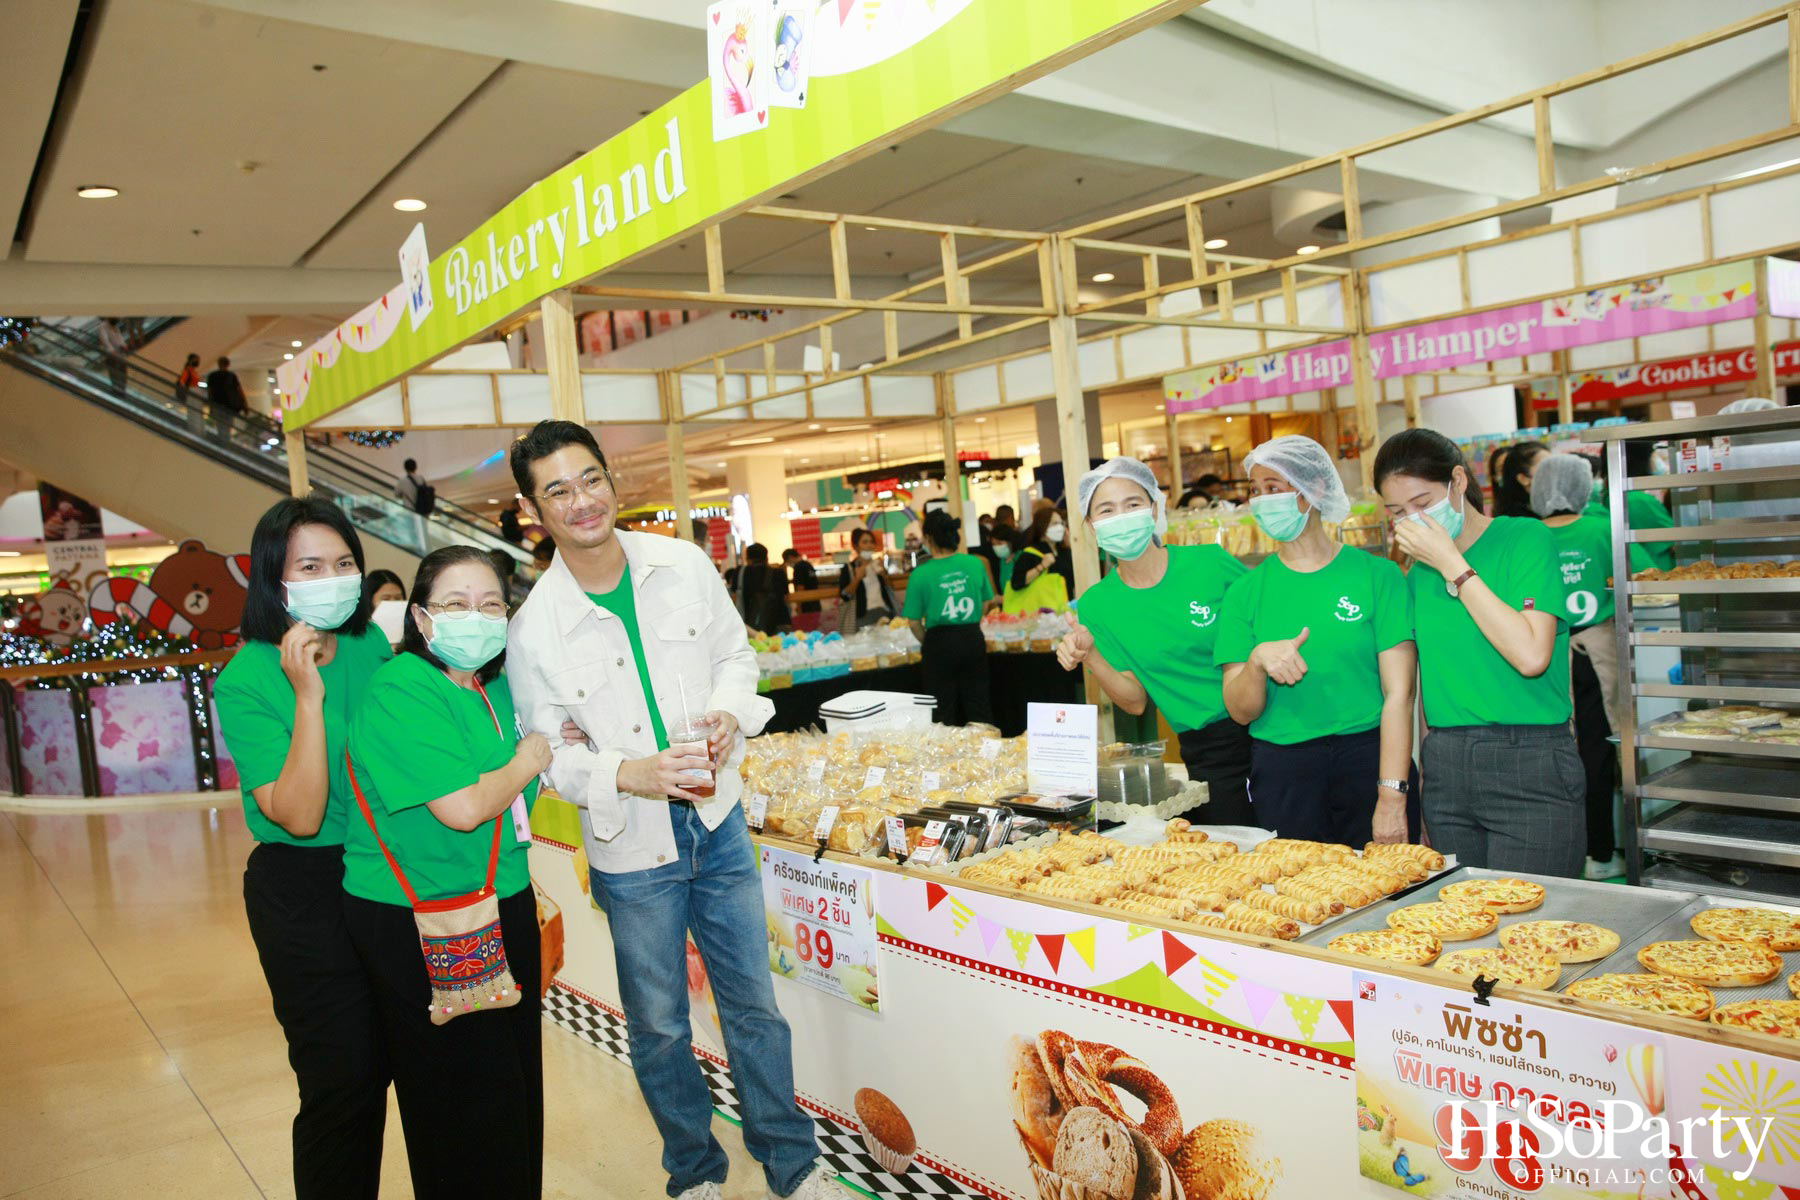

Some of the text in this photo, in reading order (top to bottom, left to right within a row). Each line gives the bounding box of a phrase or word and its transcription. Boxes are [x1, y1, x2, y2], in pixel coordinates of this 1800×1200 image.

[445, 116, 688, 316] Bakeryland
[1291, 318, 1538, 384] Hapy Hamper
[1640, 354, 1733, 387] Cookie
[941, 595, 975, 620] 49
[773, 861, 857, 904] ครัวซองท์แพ็คคู่
[781, 888, 814, 915] พิเศษ
[817, 897, 829, 921] 2
[832, 896, 850, 926] ชิ้น
[794, 922, 834, 969] 89
[835, 951, 850, 964] บาท
[1442, 1003, 1547, 1059] พิซซ่า
[1391, 1028, 1617, 1096] (ปูอัด, คาโบนาร่า, แฮมไส้กรอก, ฮาวาย)
[1394, 1049, 1483, 1099] พิเศษ
[1434, 1104, 1545, 1193] 98
